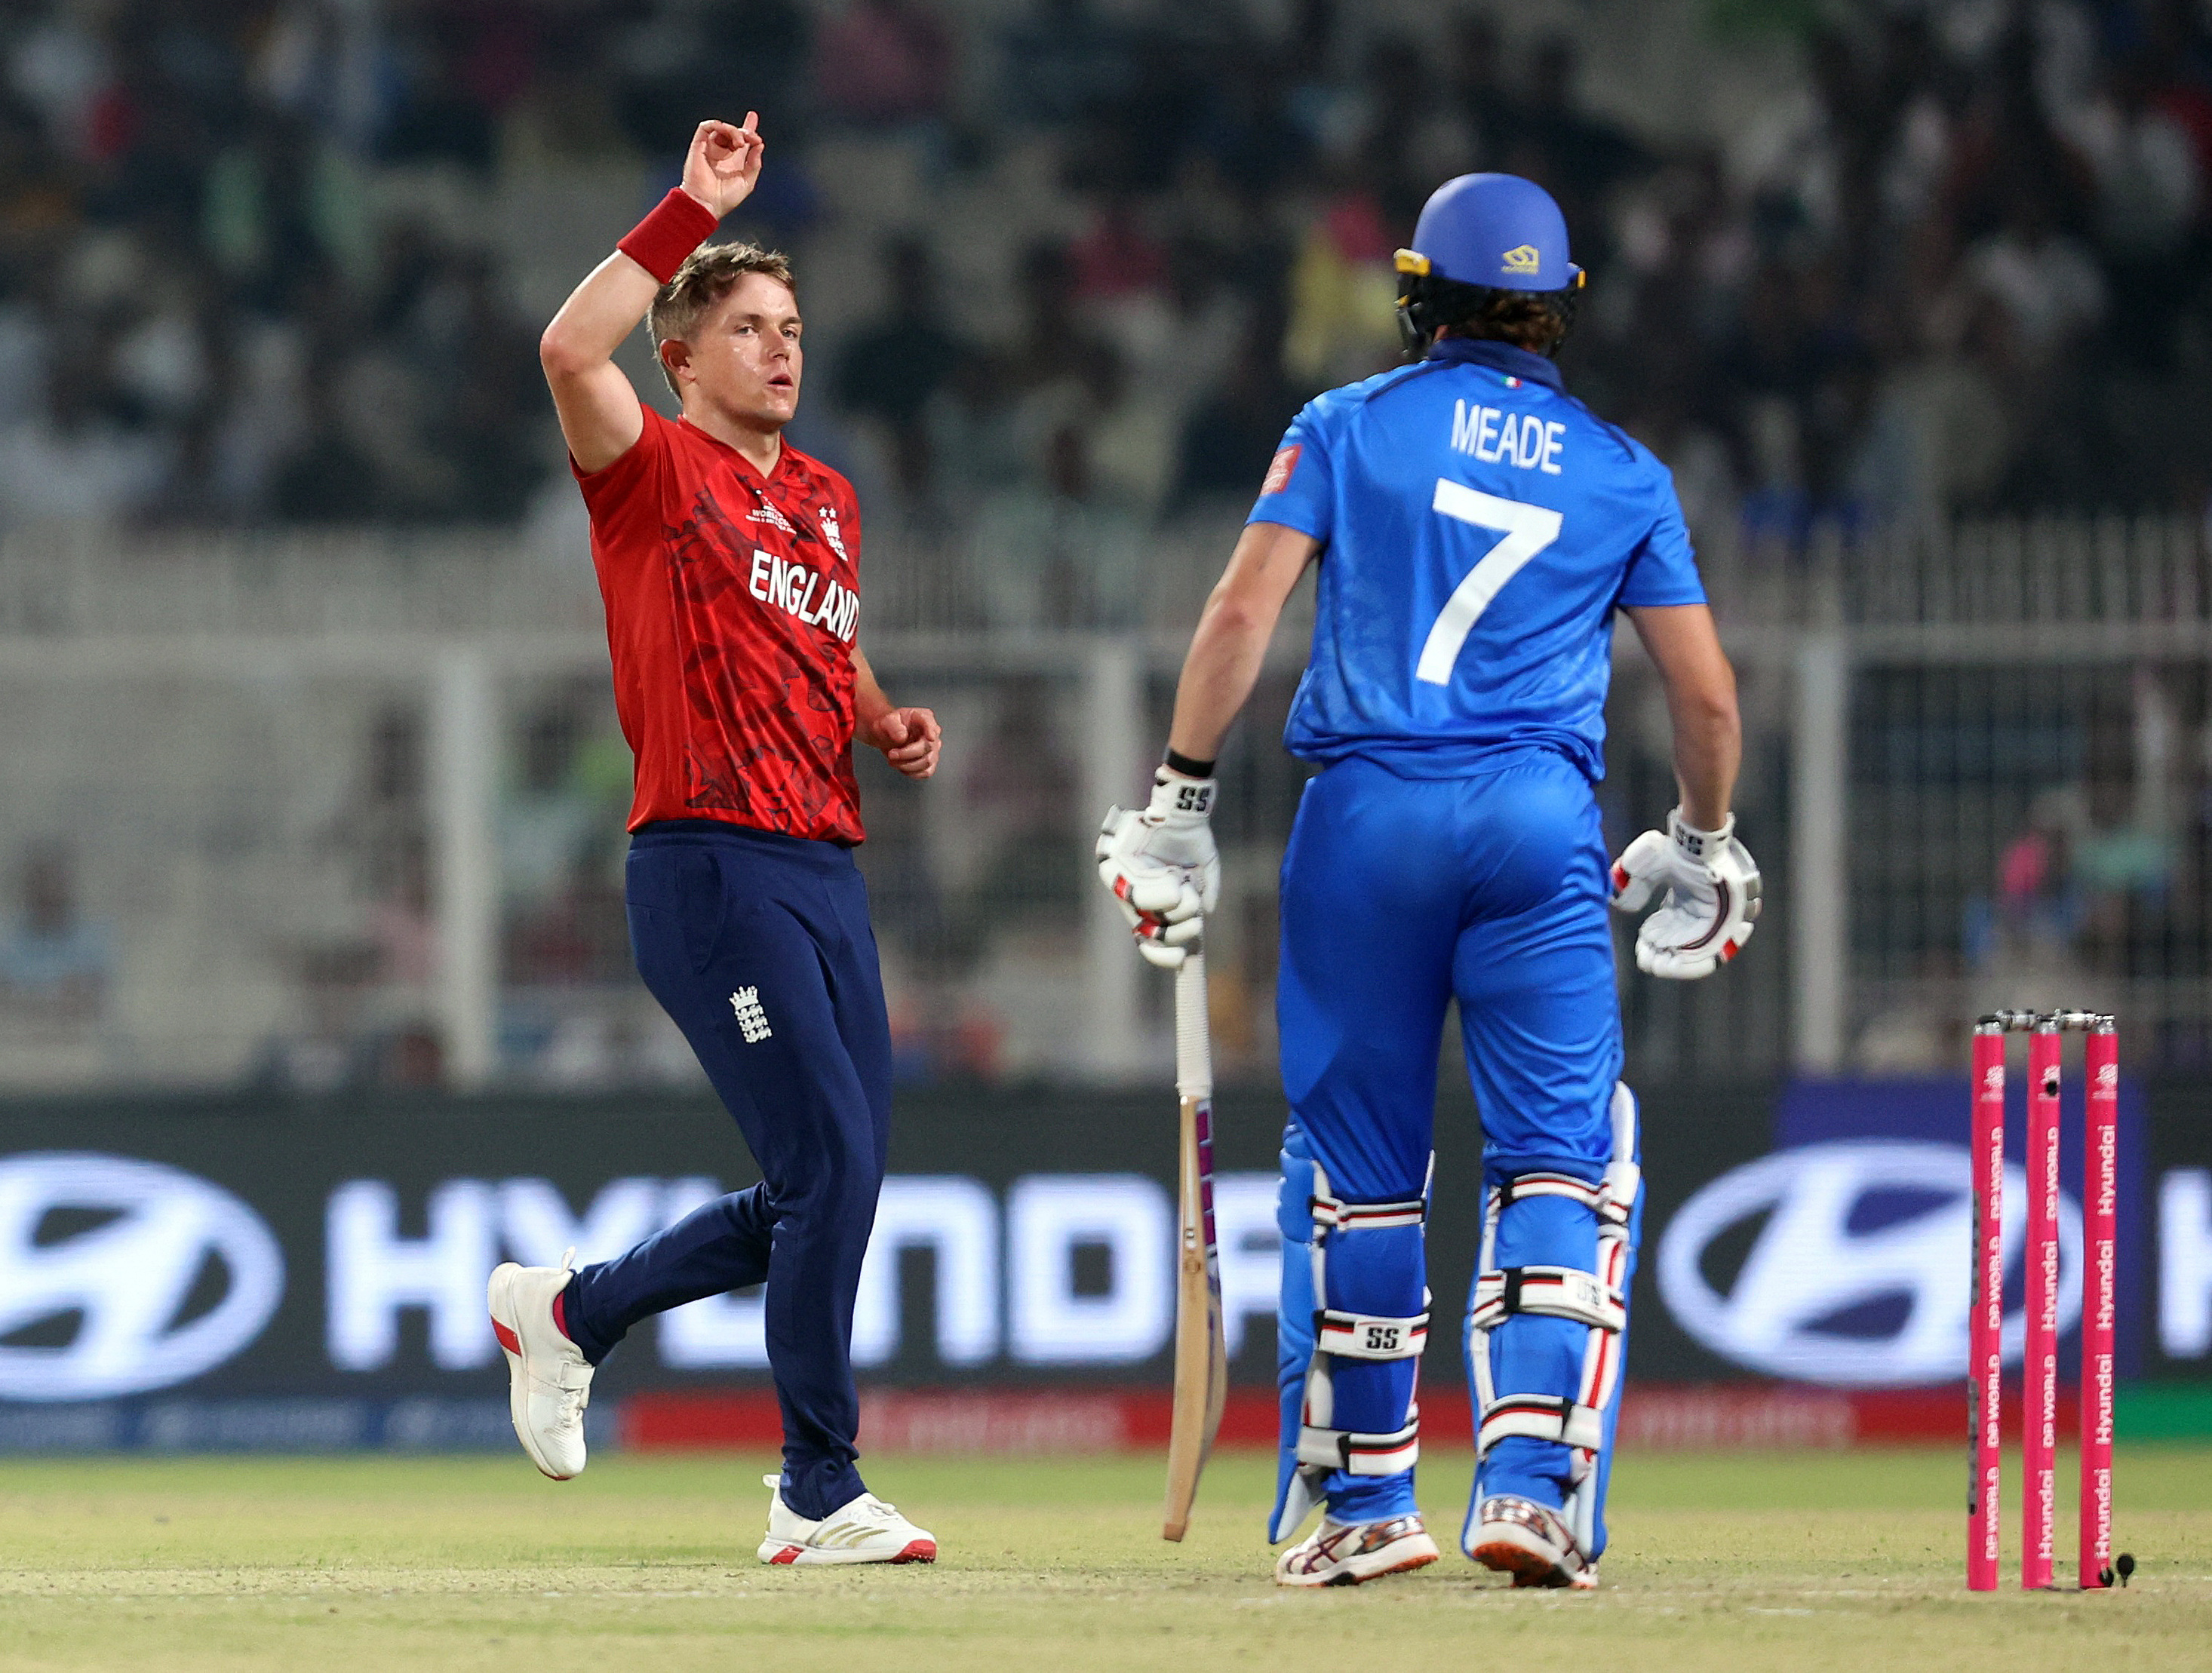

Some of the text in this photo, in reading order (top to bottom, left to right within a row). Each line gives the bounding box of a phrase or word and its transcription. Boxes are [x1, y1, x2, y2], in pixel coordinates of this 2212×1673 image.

[1450, 398, 1566, 475] MEADE
[749, 549, 860, 643] ENGLAND
[1416, 477, 1564, 687] 7
[1176, 785, 1212, 812] SS
[2097, 1125, 2116, 1216] Hyundai
[324, 1174, 1283, 1371] HYND
[2041, 1239, 2058, 1332] Hyundai
[2097, 1239, 2115, 1331] Hyundai
[1366, 1327, 1399, 1349] SS
[1987, 1354, 2001, 1422] WORLD
[2043, 1354, 2057, 1422] WORLD
[2094, 1353, 2113, 1445] Hyundai
[2038, 1469, 2054, 1559] Hyundai
[2094, 1468, 2112, 1559] Hyundai
